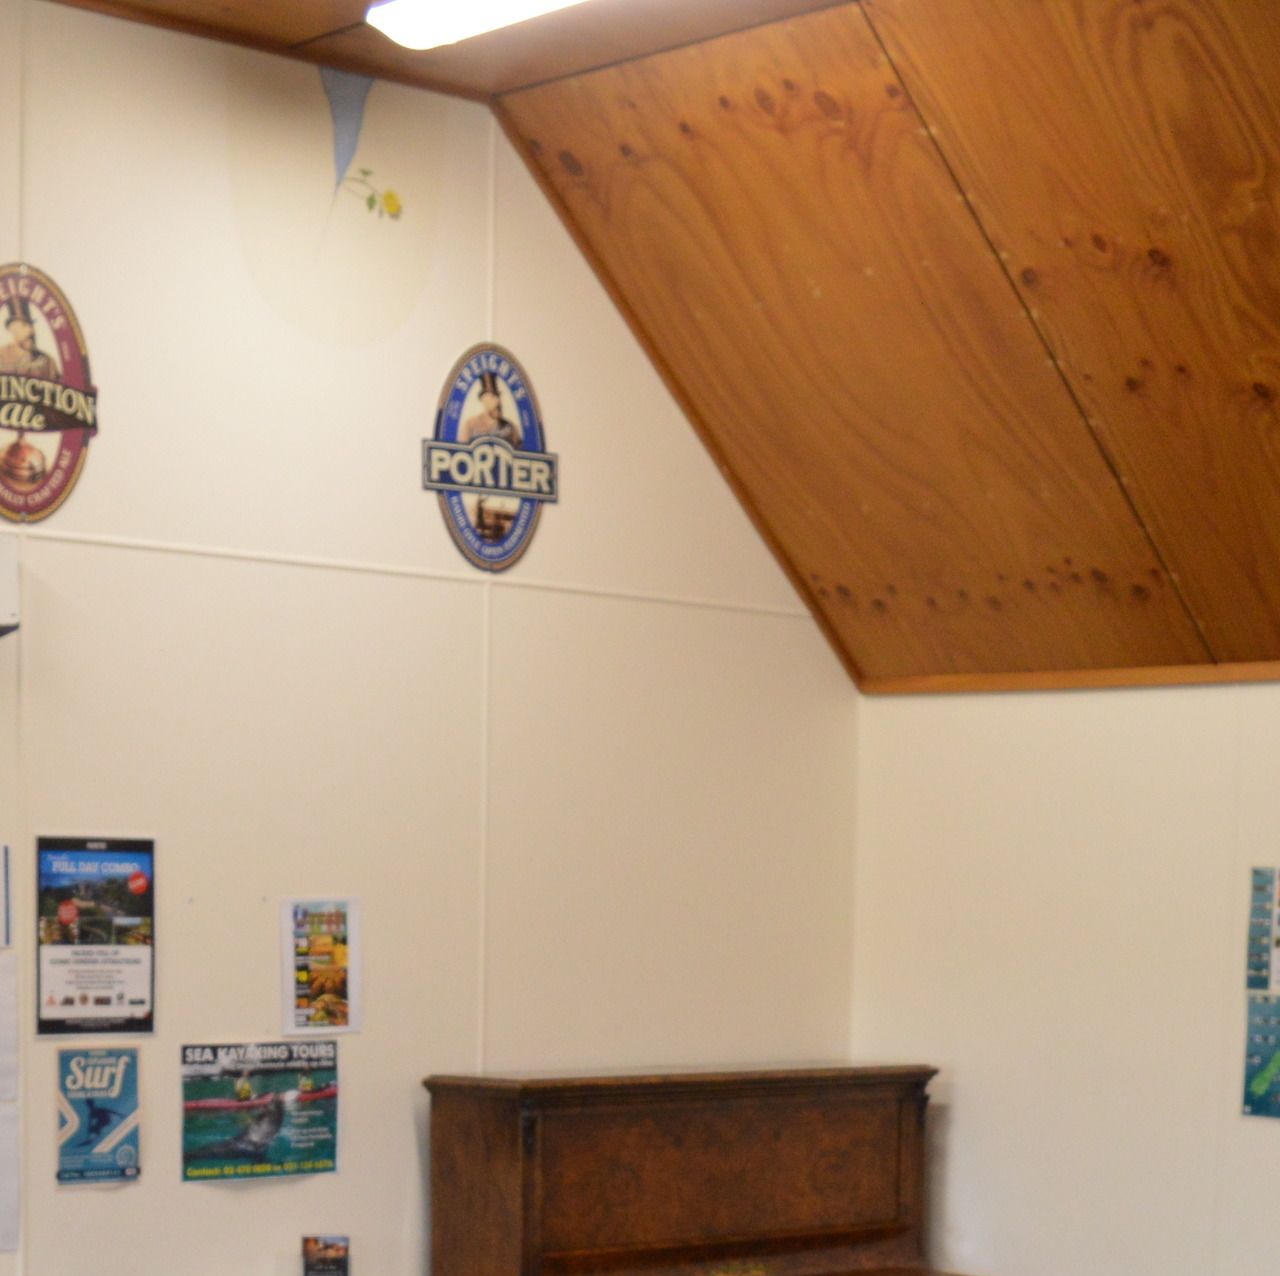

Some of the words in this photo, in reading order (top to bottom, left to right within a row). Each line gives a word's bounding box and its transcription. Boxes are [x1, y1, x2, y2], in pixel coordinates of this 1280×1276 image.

[430, 445, 551, 493] PORTER
[185, 1047, 214, 1062] SEA
[217, 1045, 289, 1061] KAYAKING
[291, 1043, 335, 1059] TOURS
[65, 1055, 130, 1099] Surf
